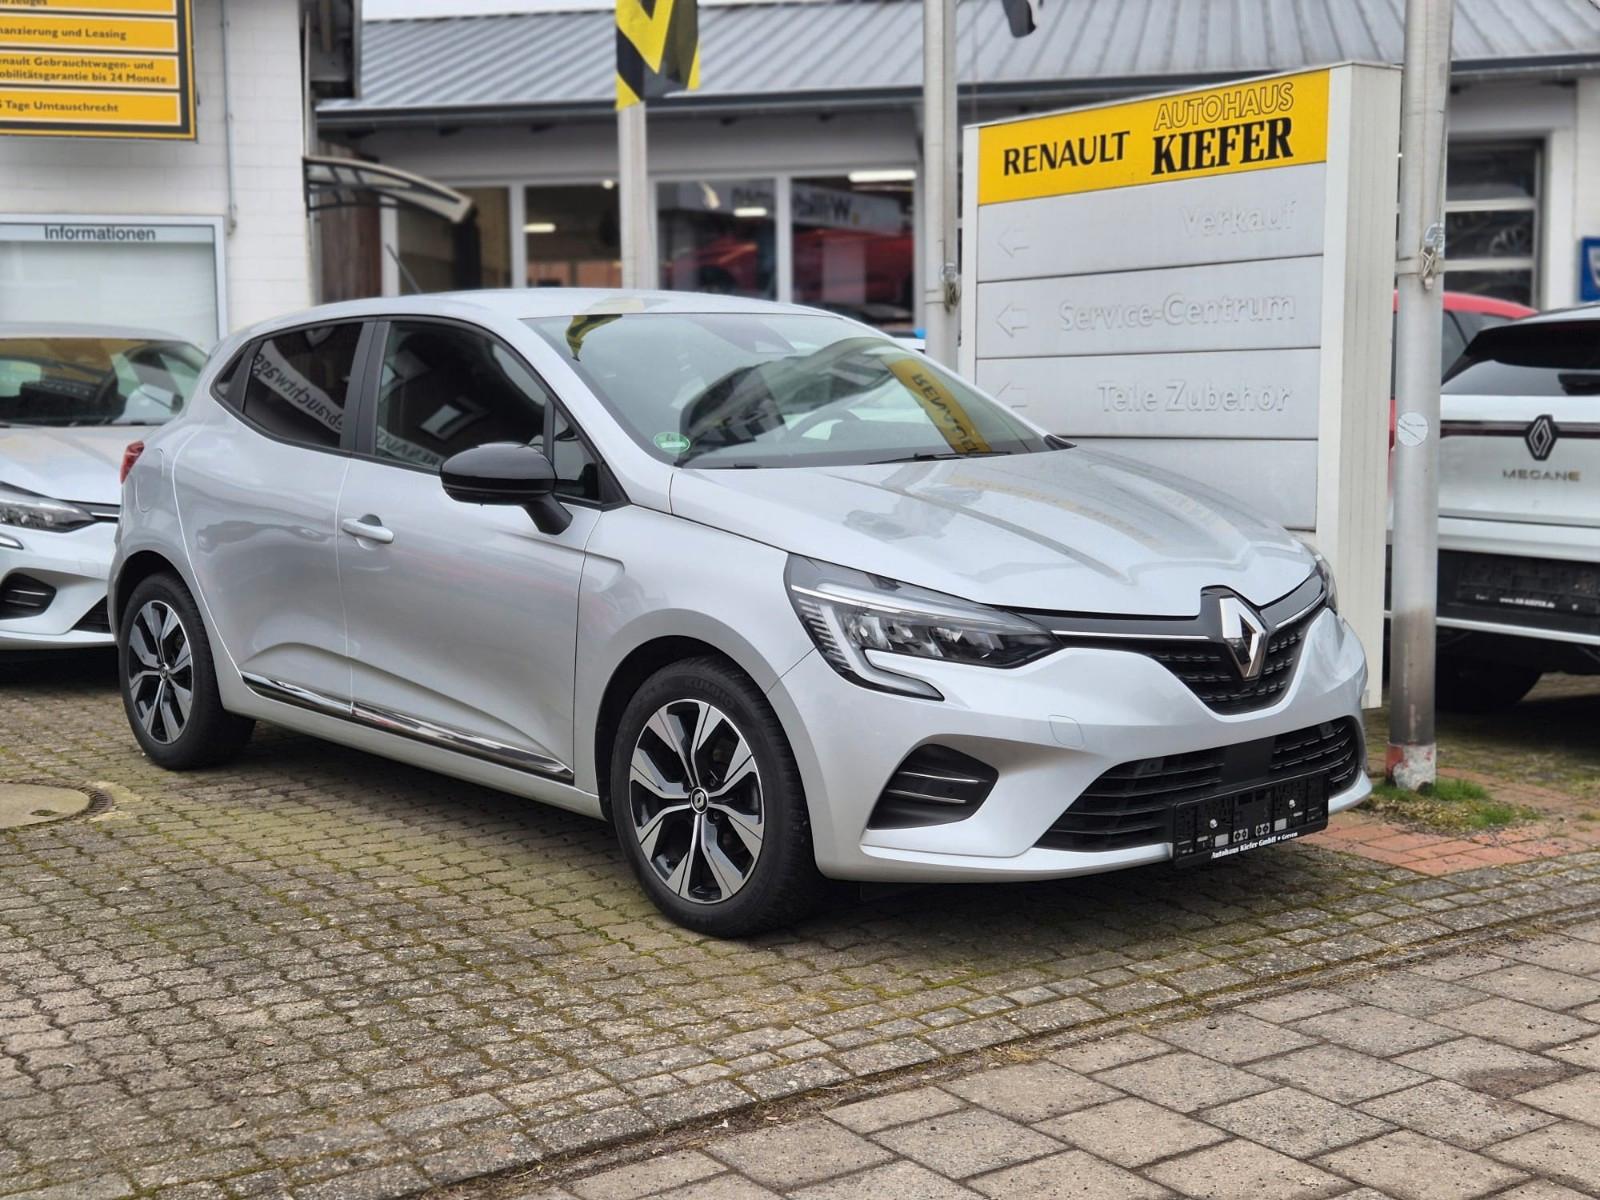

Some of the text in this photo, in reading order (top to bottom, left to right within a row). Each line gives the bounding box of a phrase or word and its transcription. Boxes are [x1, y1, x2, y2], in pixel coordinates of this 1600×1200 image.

[62, 28, 81, 37] und
[85, 28, 127, 40] Leasing
[92, 72, 107, 81] bis
[111, 73, 122, 82] 24
[126, 73, 167, 83] Monate
[134, 61, 154, 70] und
[5, 99, 30, 112] Tage
[33, 101, 119, 113] Umtauschrecht
[1153, 82, 1294, 131] AUTOHAUS
[1003, 131, 1130, 176] RENAULT
[1151, 117, 1294, 175] KIEFER
[1180, 201, 1296, 238] Verkauf
[44, 225, 156, 241] Informationen
[1058, 291, 1296, 332] Service-Centrum
[1098, 378, 1291, 412] Teile Zubehör
[1502, 469, 1581, 482] MEGANE
[1211, 847, 1239, 860] Autohaus
[1240, 841, 1258, 852] Kiefer
[1259, 836, 1277, 847] GmbH
